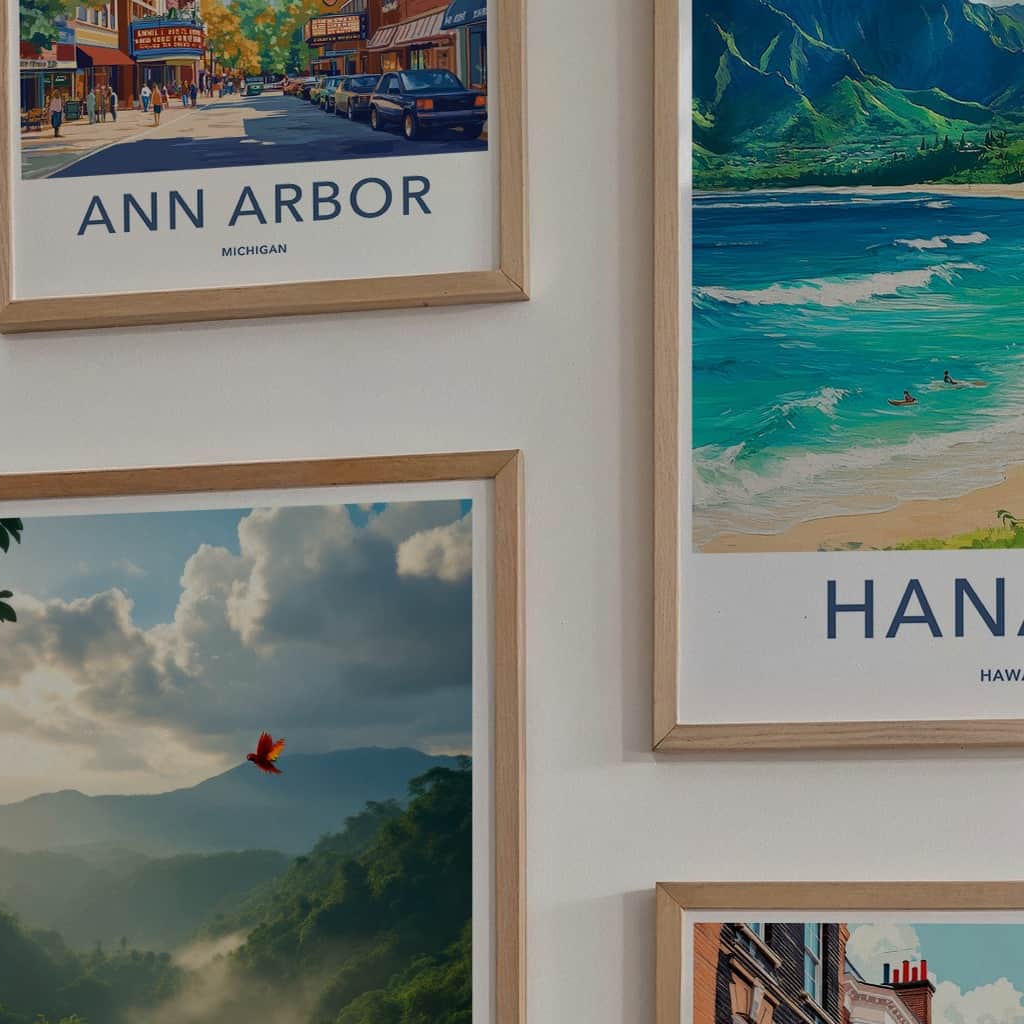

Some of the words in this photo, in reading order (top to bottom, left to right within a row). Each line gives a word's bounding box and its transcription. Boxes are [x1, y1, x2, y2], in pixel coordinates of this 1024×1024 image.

[77, 188, 205, 236] ANN
[228, 175, 432, 227] ARBOR
[221, 243, 287, 257] MICHIGAN
[826, 577, 1024, 640] HAN
[980, 668, 1024, 682] HAW
